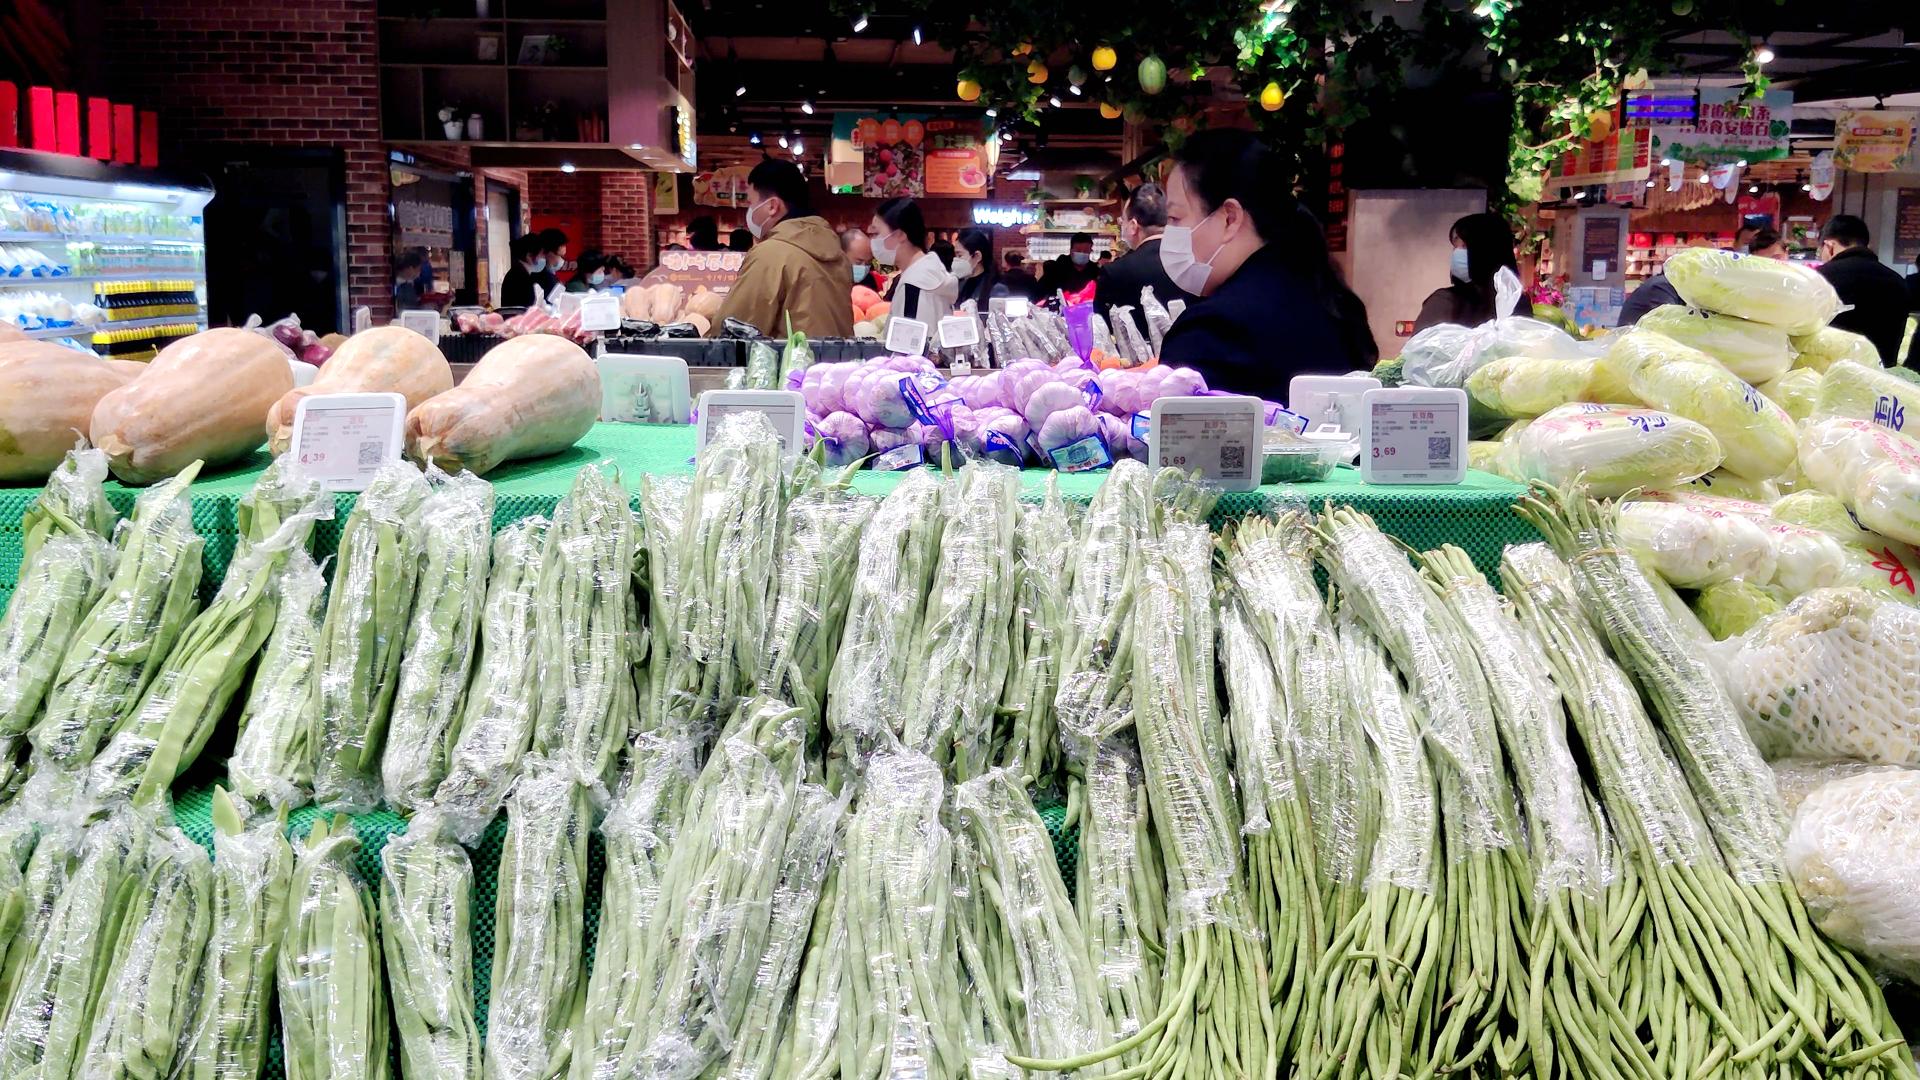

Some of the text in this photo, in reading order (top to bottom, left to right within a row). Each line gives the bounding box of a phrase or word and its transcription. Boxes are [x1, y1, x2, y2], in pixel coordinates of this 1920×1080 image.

[1372, 447, 1396, 458] 3.69
[301, 453, 326, 465] 4.39
[1161, 456, 1186, 467] 3.69
